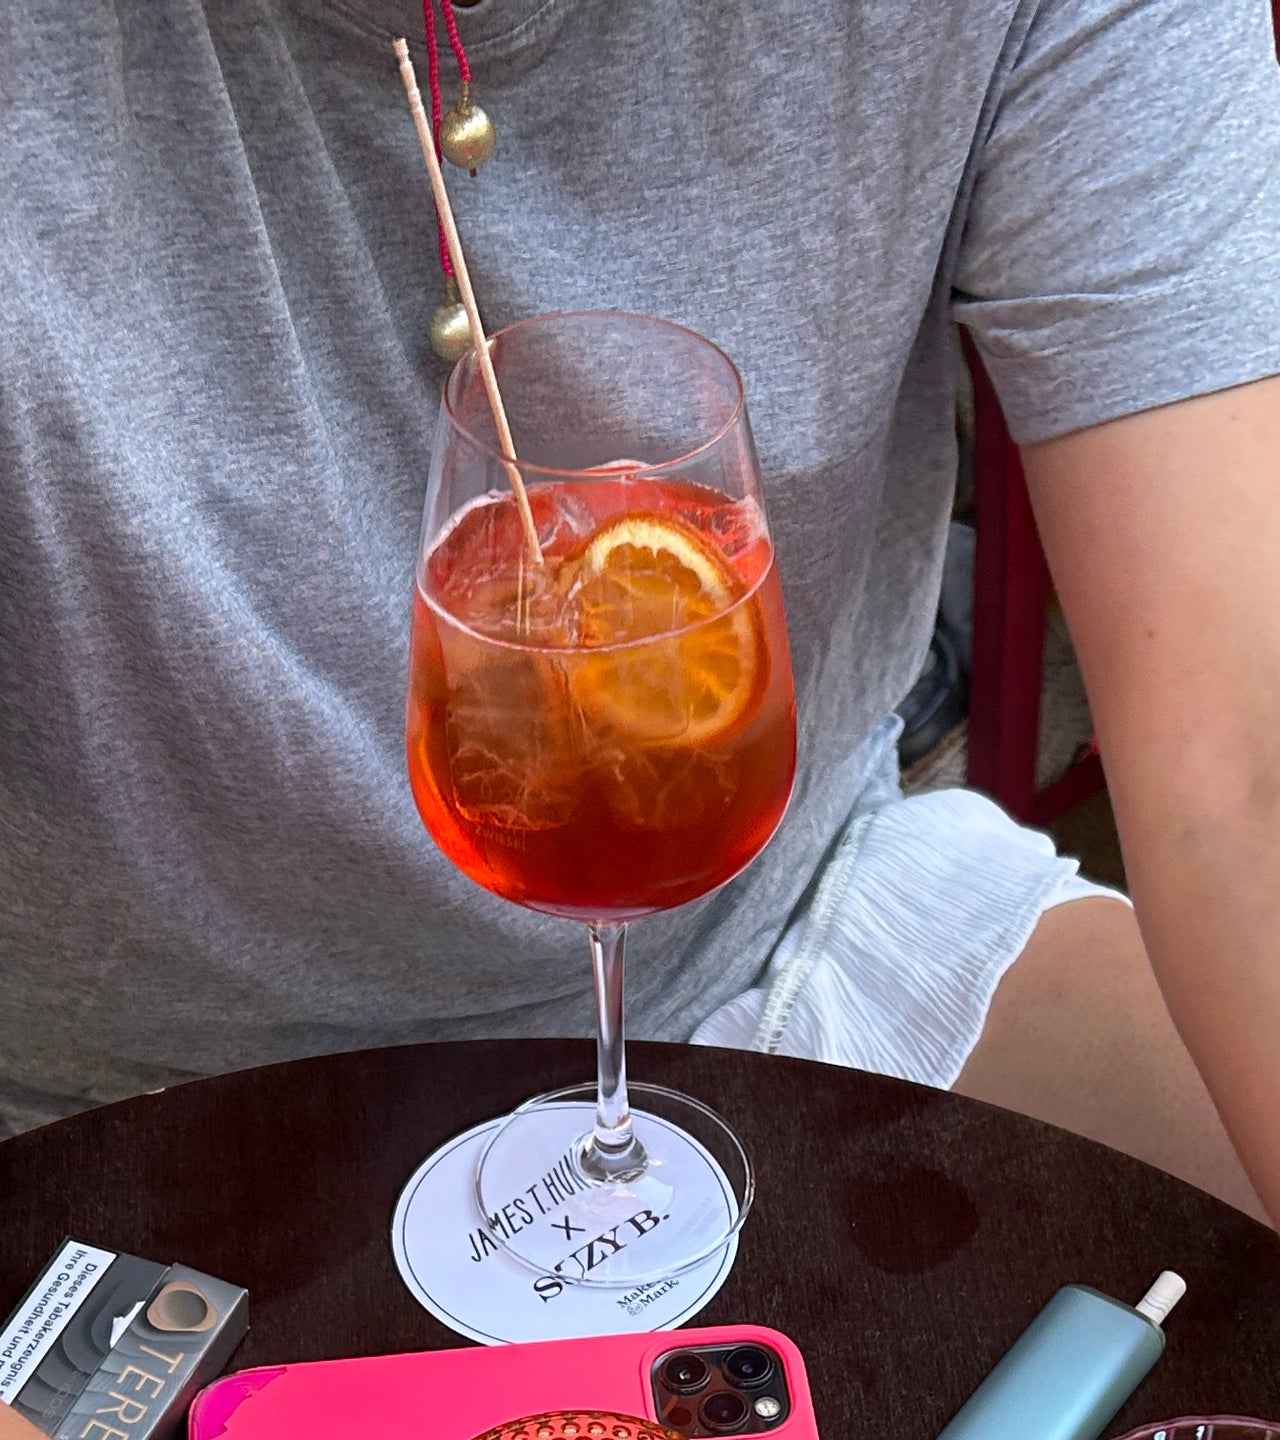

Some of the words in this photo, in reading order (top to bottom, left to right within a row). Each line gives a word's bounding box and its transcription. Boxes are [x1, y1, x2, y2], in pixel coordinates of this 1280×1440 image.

[469, 1198, 534, 1263] JAMES
[624, 1209, 670, 1238] B.
[64, 1249, 88, 1270] Ihre
[63, 1262, 98, 1299] Dieses
[616, 1277, 666, 1308] Make
[18, 1272, 70, 1335] Gesundheit
[0, 1302, 71, 1388] Tabakerzeugnis
[1, 1335, 23, 1359] und
